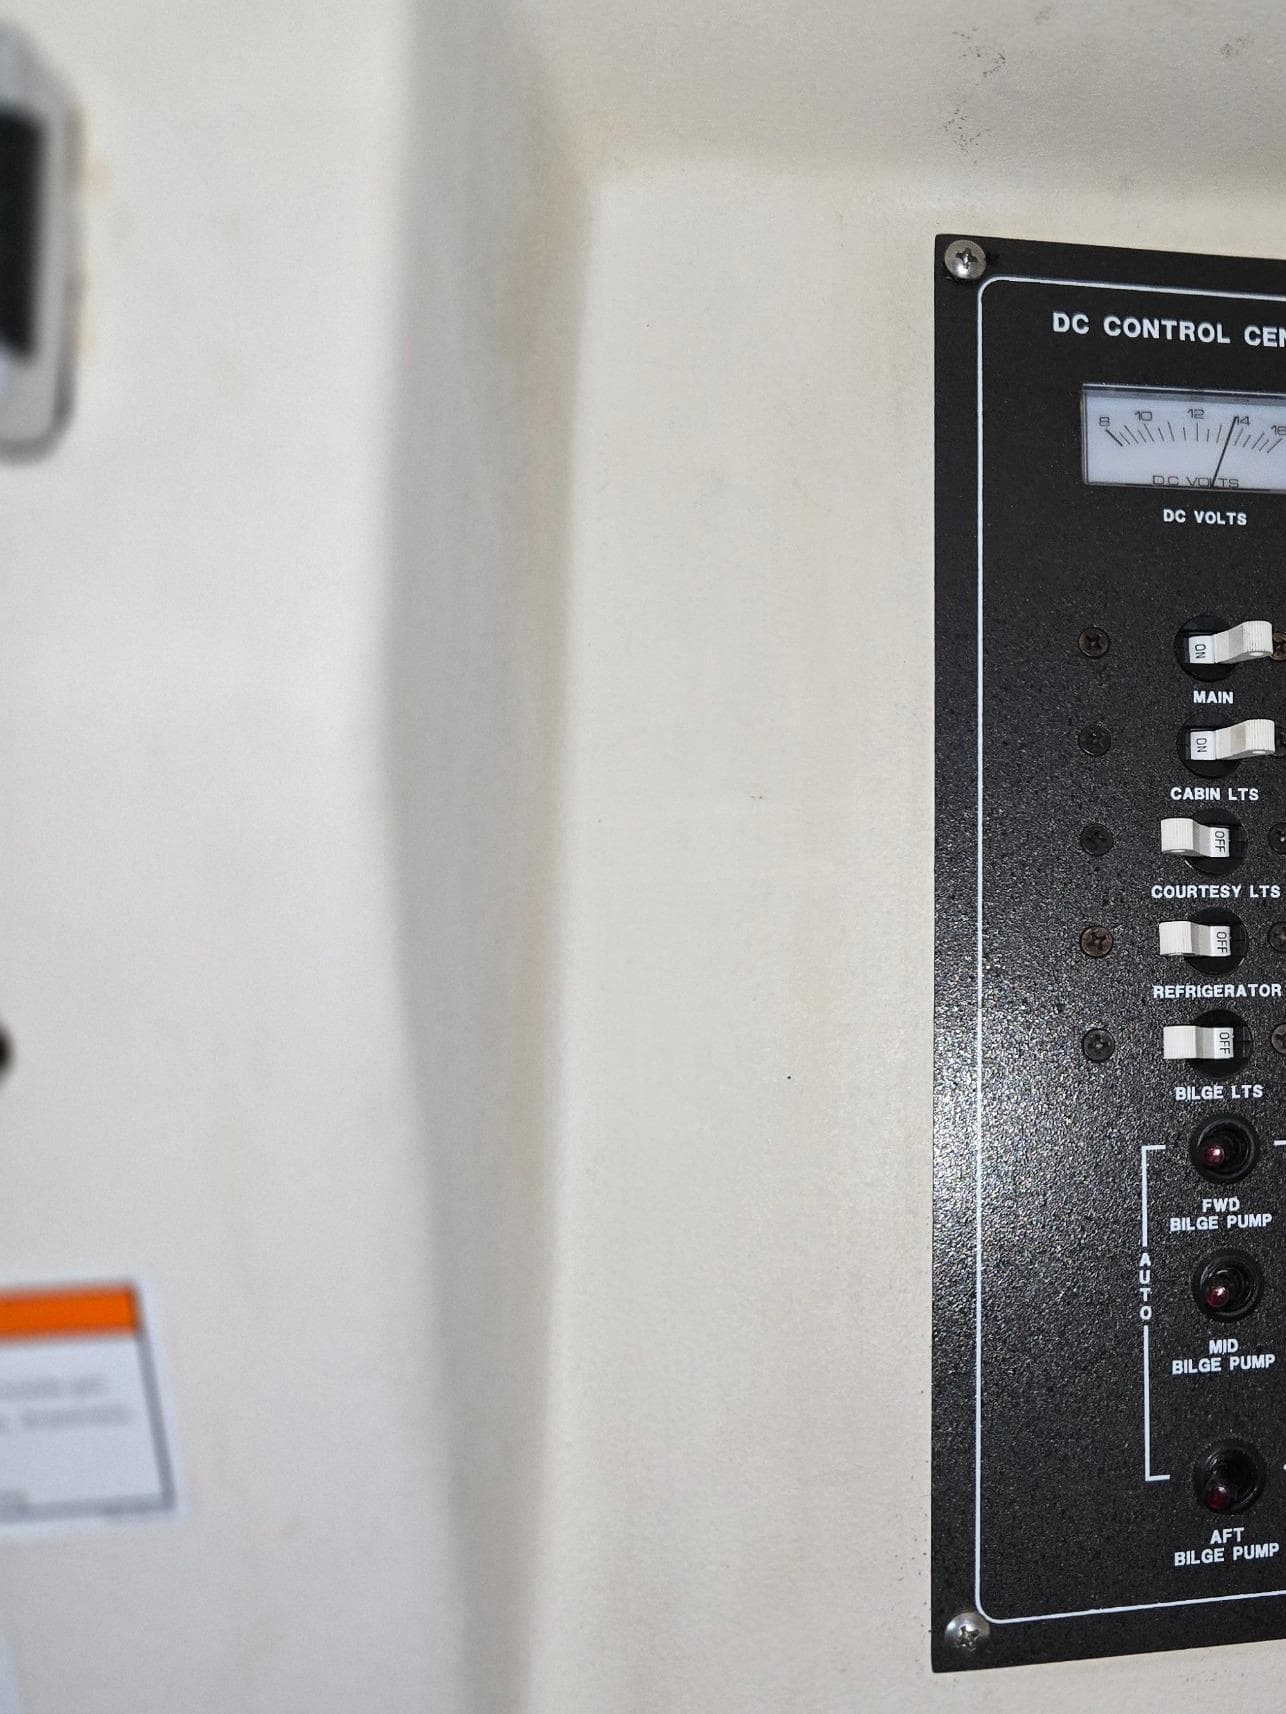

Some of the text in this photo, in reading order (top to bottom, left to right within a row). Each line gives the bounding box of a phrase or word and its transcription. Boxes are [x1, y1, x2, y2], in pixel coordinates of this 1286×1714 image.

[1053, 312, 1089, 334] DC
[1104, 316, 1230, 343] CONTROL
[1099, 416, 1110, 427] 8
[1134, 411, 1153, 422] 10
[1188, 409, 1205, 420] 12
[1164, 509, 1246, 525] DC VOLTS
[1195, 643, 1206, 659] ON
[1194, 691, 1233, 704] MAIN
[1170, 787, 1259, 801] CABIN LTS
[1214, 831, 1225, 853] OFF
[1151, 884, 1280, 899] COURTESY LTS
[1216, 931, 1227, 953] OFF
[1152, 984, 1282, 999] REFRIGERATOR
[1219, 1031, 1230, 1055] OFF
[1175, 1084, 1264, 1101] BILGE LTS
[1202, 1196, 1240, 1212] FWD
[1169, 1213, 1273, 1232] BILGE PUMP
[1139, 1252, 1152, 1321] AUTO
[1209, 1338, 1239, 1355] MID
[1172, 1353, 1276, 1375] BILGE PUMP
[1210, 1527, 1245, 1545] AFT
[1174, 1543, 1280, 1567] BILGE PUMP
